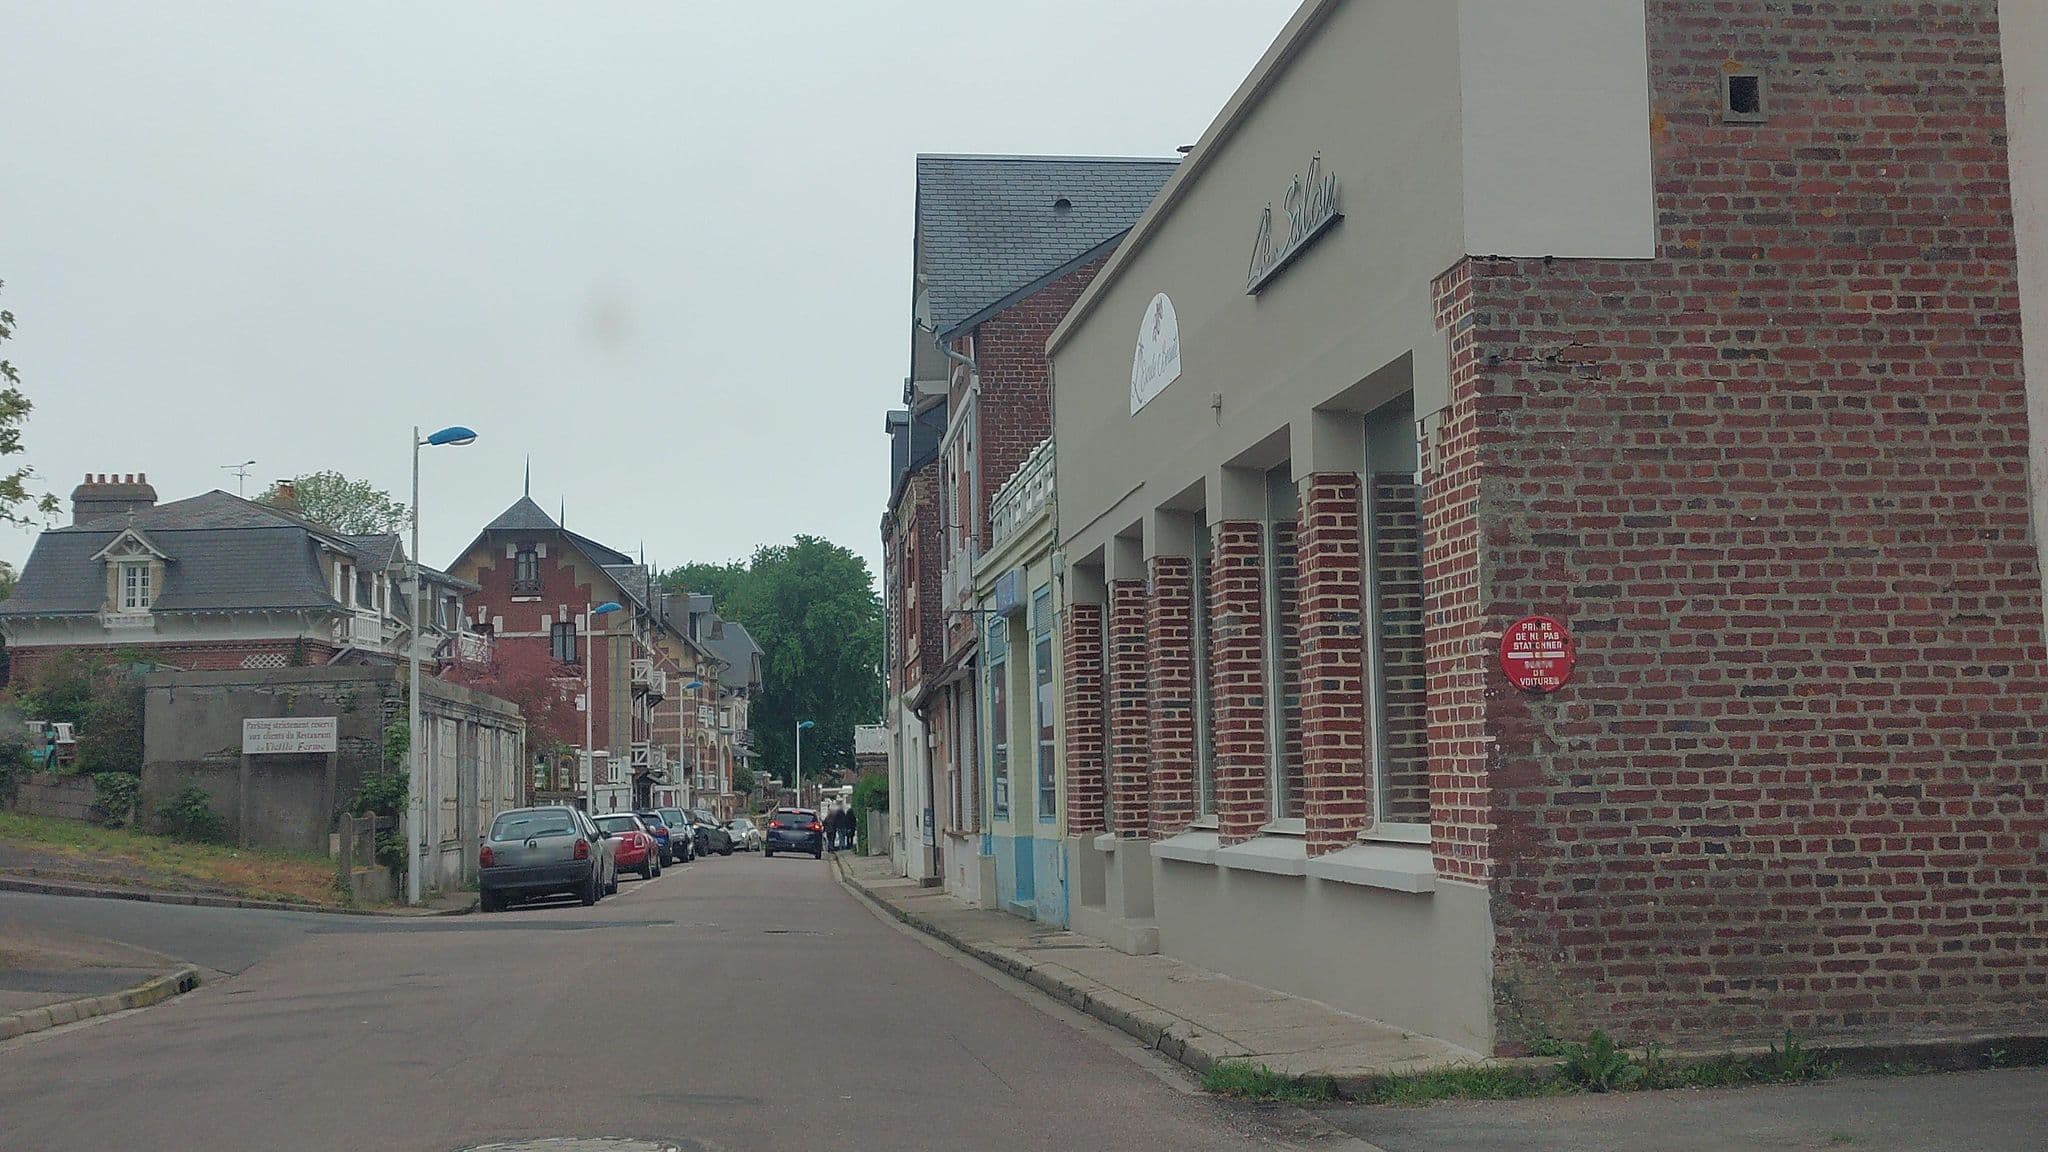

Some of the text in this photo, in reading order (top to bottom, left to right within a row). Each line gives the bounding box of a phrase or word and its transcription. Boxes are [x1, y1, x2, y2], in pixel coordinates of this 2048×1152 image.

[1521, 622, 1552, 631] PRIRE
[1515, 632, 1527, 641] DE
[1543, 632, 1559, 640] PAS
[1513, 641, 1562, 650] STATONNER
[246, 721, 271, 730] Parking
[272, 721, 309, 729] strictement
[296, 731, 331, 740] Restaurant
